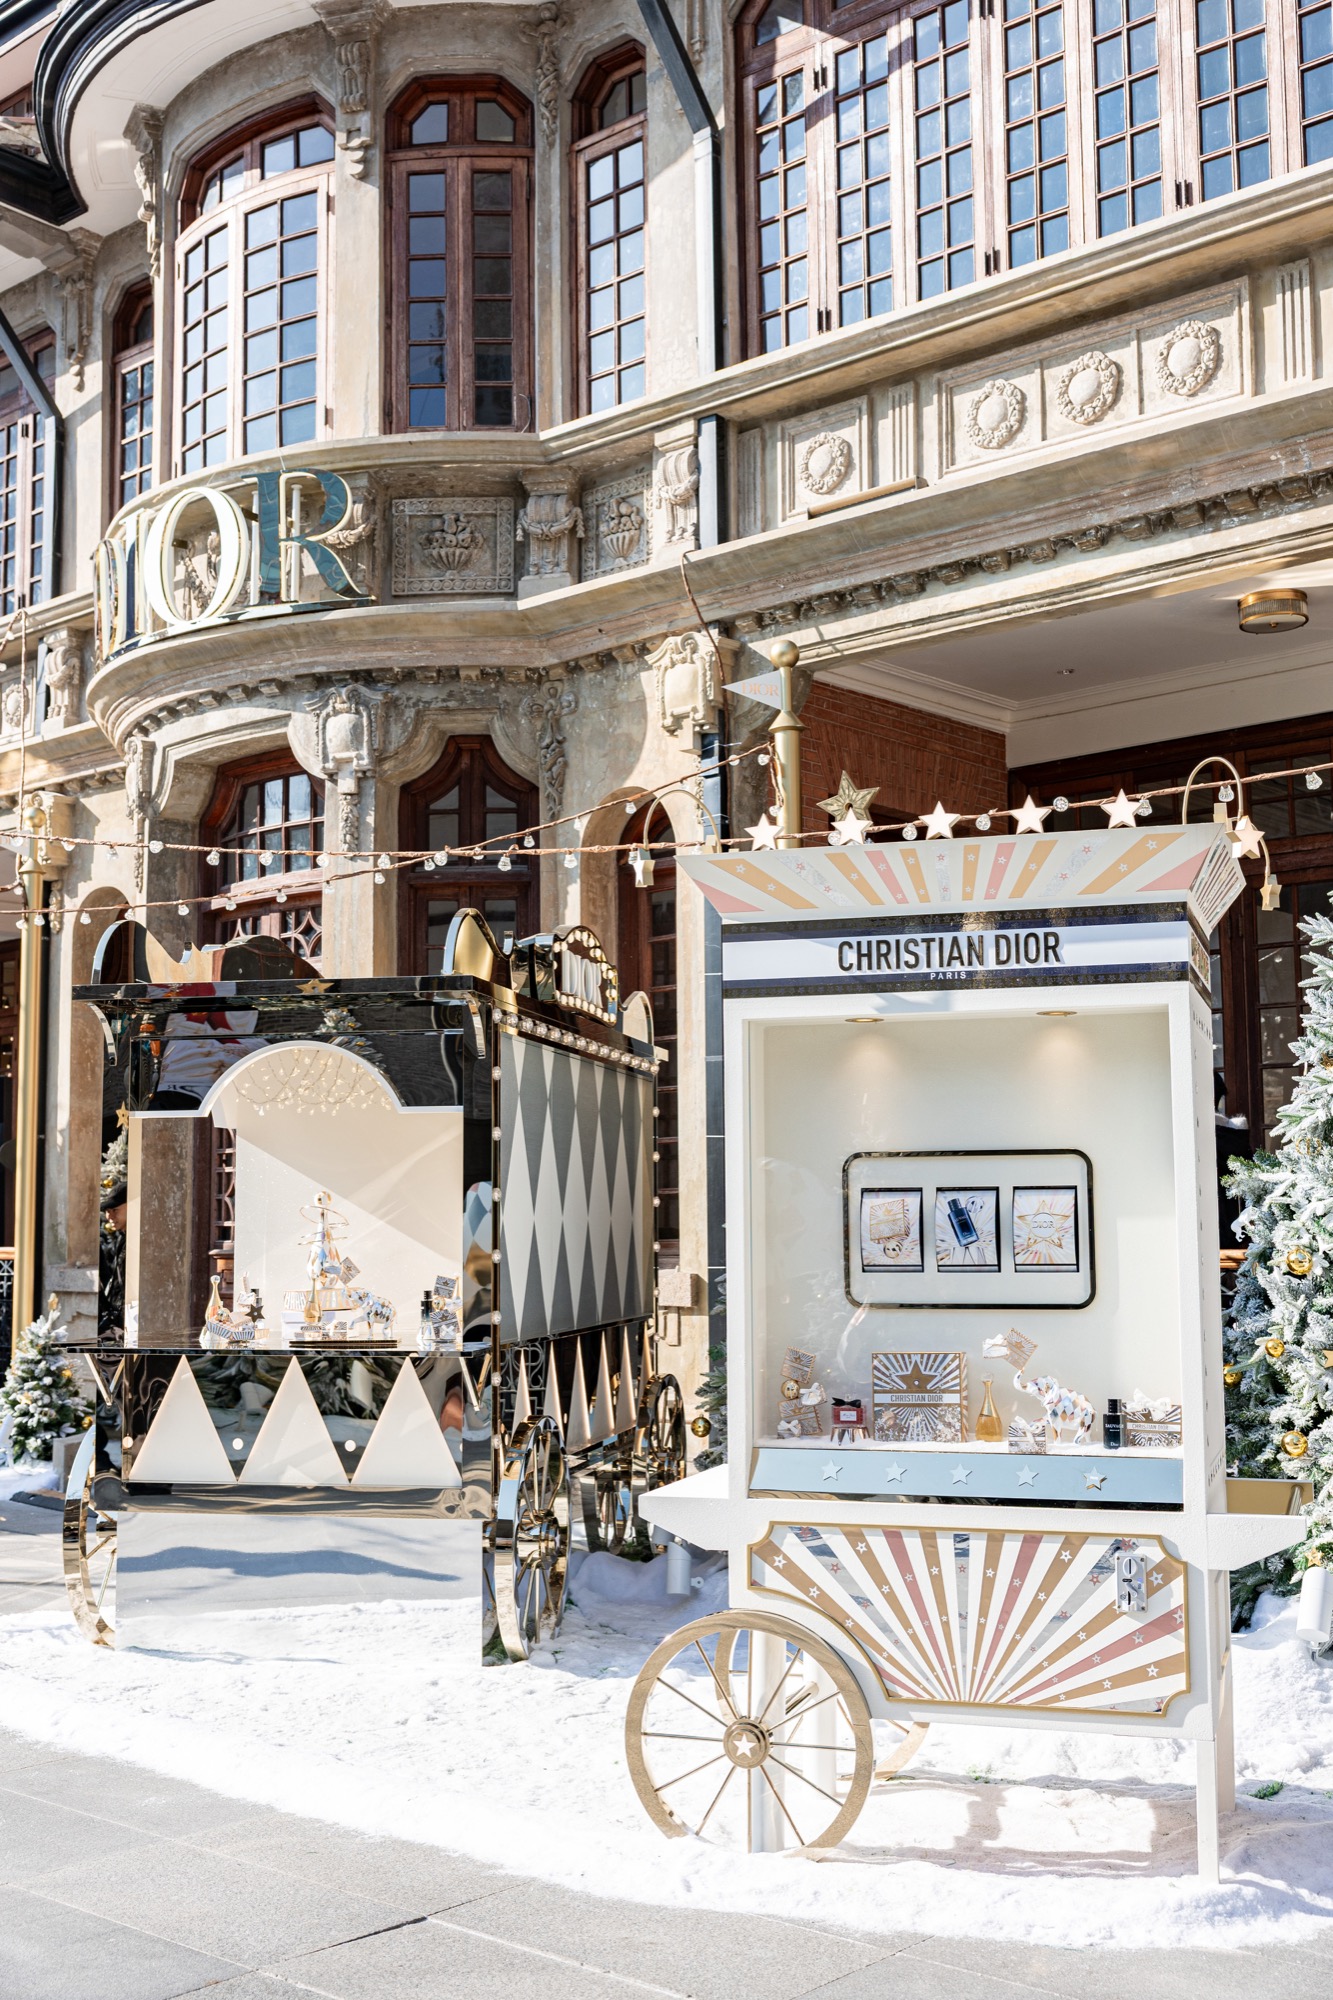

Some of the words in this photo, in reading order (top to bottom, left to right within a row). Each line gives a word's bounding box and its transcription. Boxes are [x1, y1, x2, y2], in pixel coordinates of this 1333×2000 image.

[90, 468, 377, 660] DIOR
[741, 682, 780, 697] DIOR
[837, 934, 985, 972] CHRISTIAN
[994, 931, 1061, 966] DIOR
[561, 949, 604, 1009] DIOR
[930, 971, 967, 981] PARIS
[1032, 1220, 1055, 1229] DIOR
[890, 1394, 926, 1403] CHRISTIAN
[927, 1394, 944, 1402] DIOR
